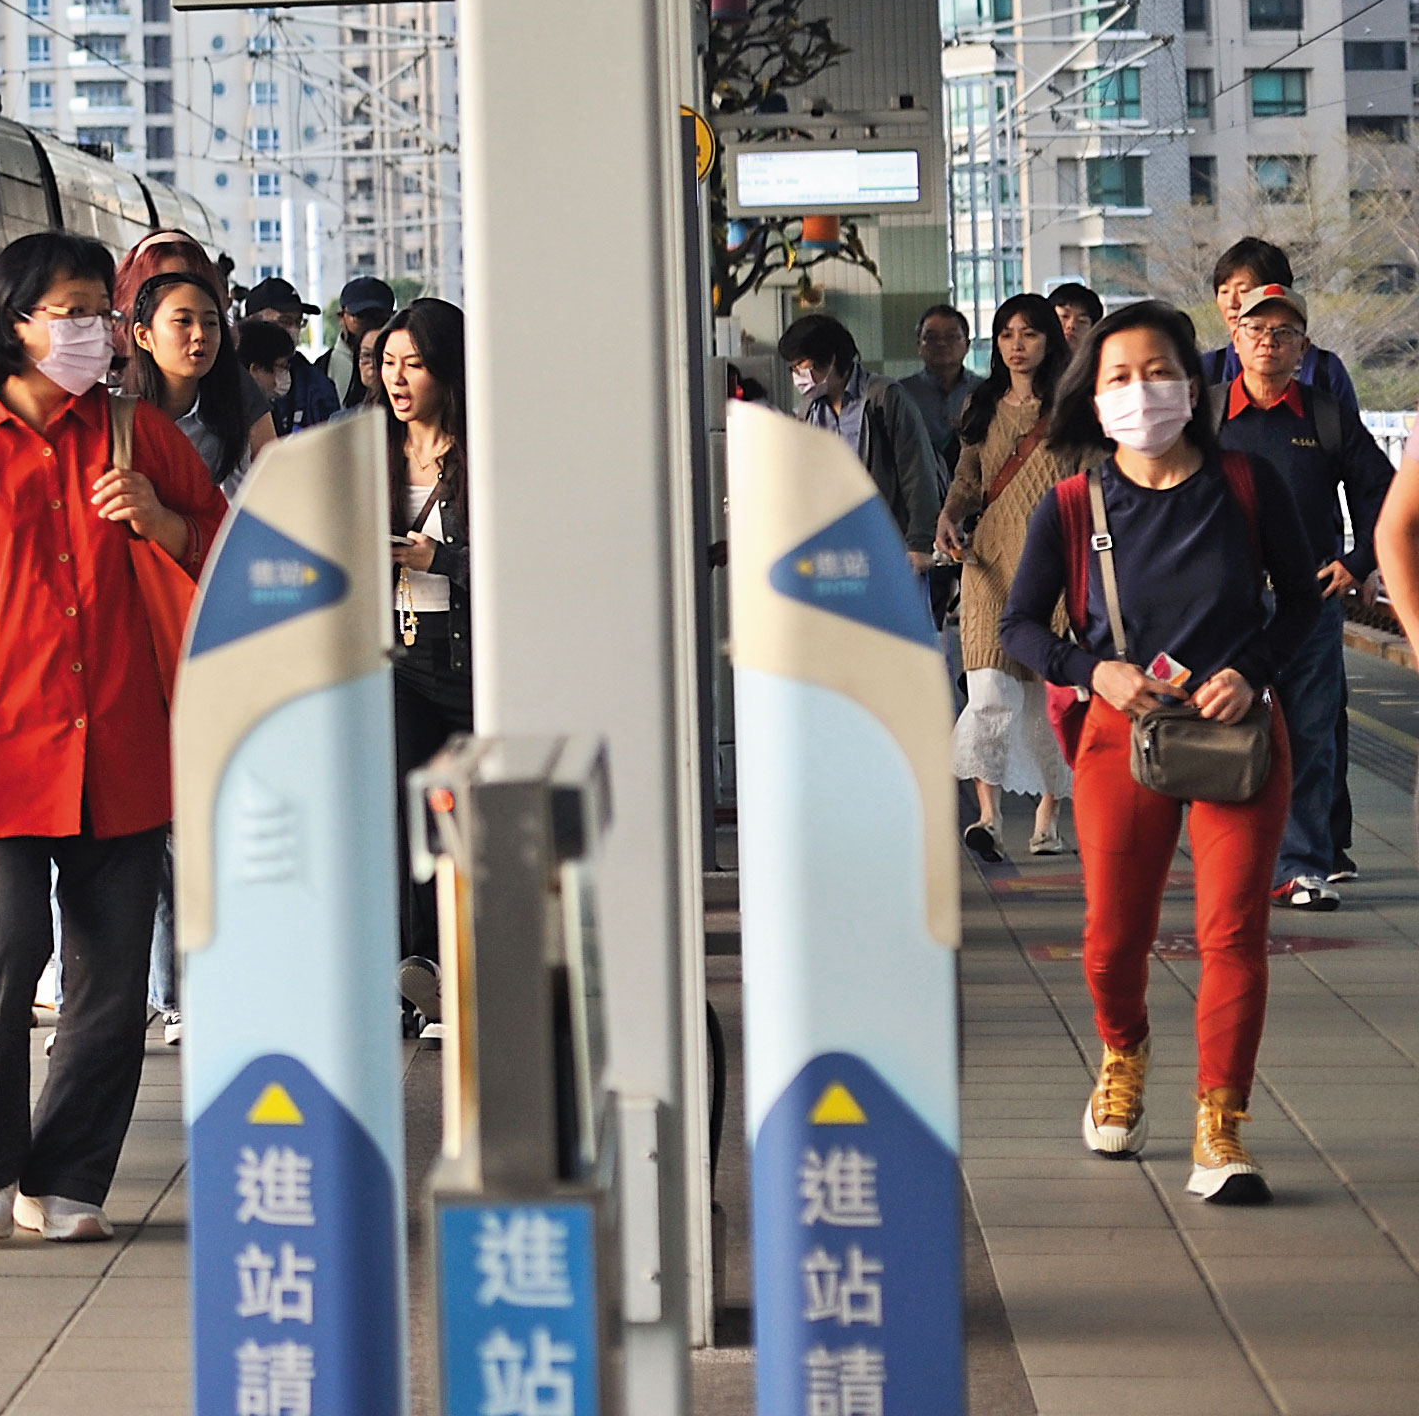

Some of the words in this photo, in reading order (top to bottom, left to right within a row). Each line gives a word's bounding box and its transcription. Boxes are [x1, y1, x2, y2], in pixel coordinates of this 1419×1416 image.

[235, 1146, 316, 1416] 進站請
[474, 1210, 575, 1416] 進站
[799, 1146, 887, 1416] 進站請
